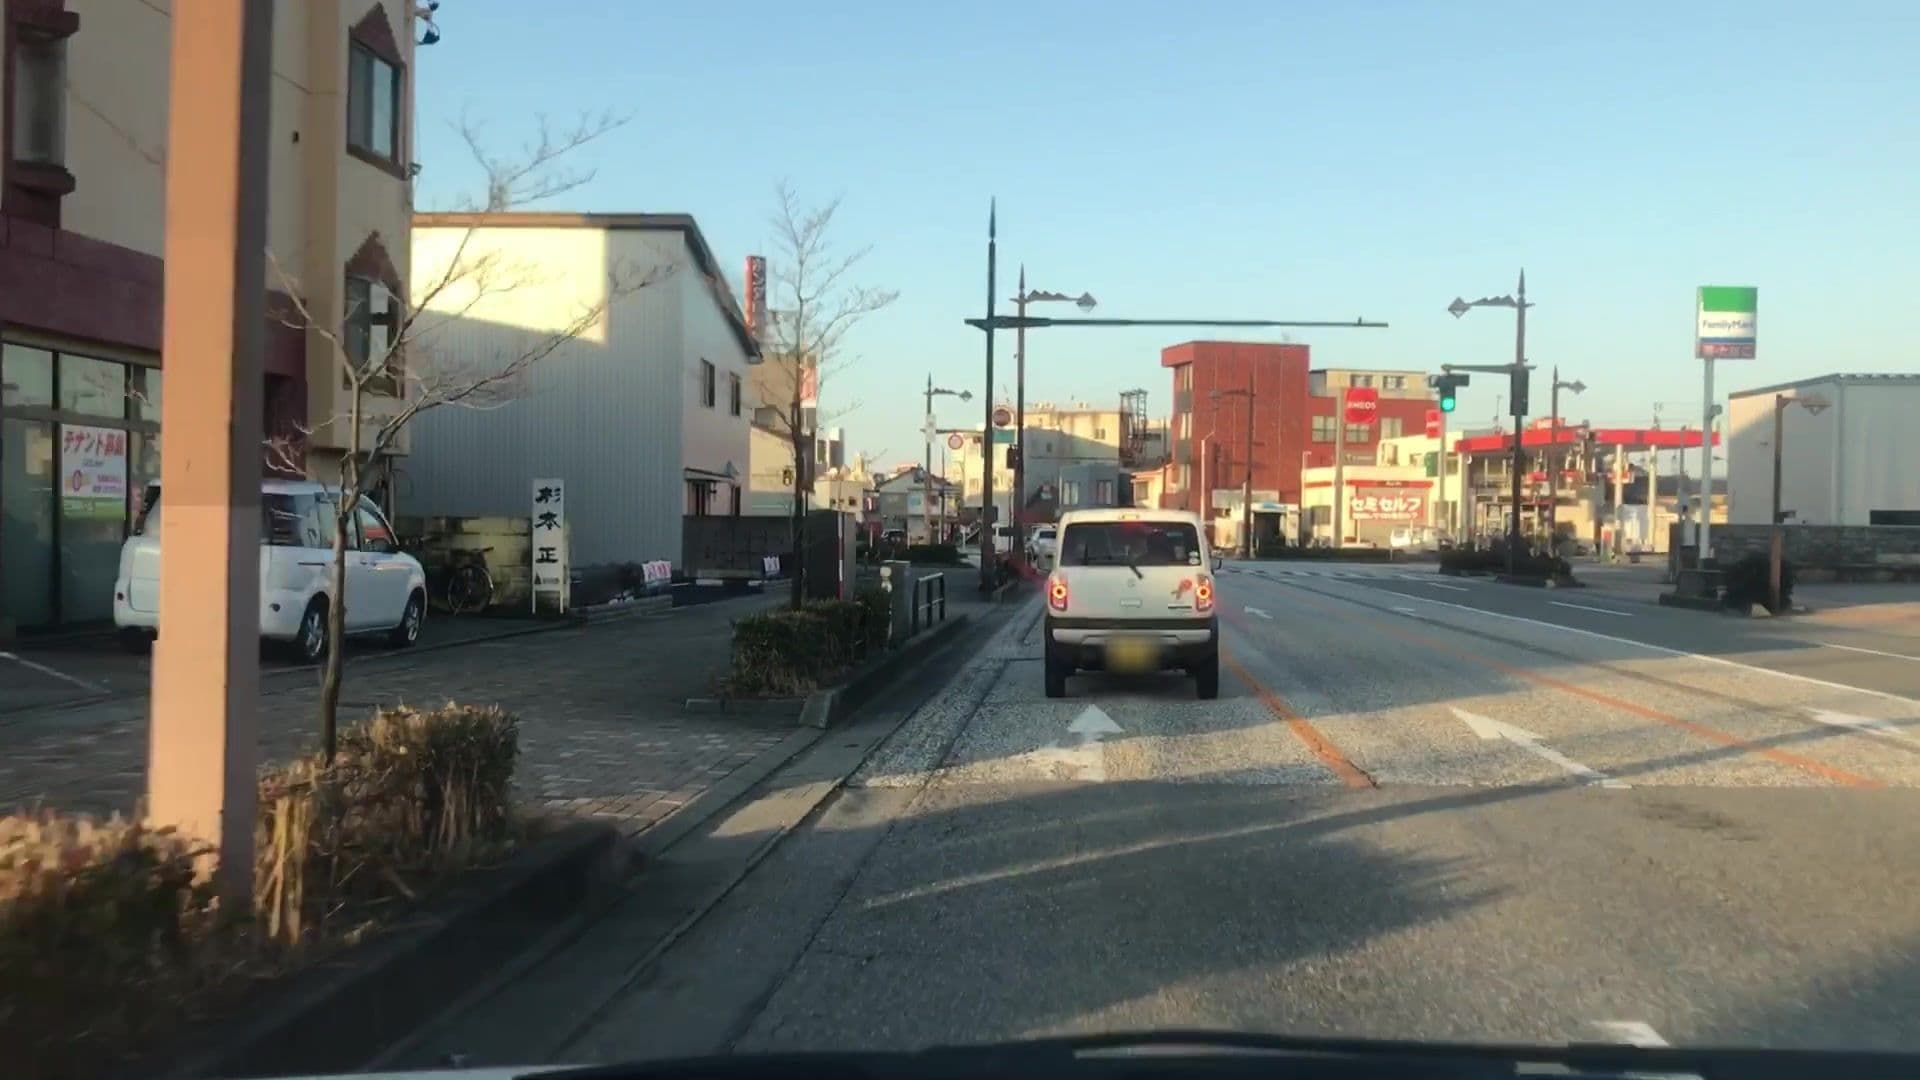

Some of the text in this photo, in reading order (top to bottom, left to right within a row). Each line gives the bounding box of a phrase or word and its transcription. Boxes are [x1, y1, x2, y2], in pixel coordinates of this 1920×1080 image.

[1351, 496, 1422, 512] セミセルフ
